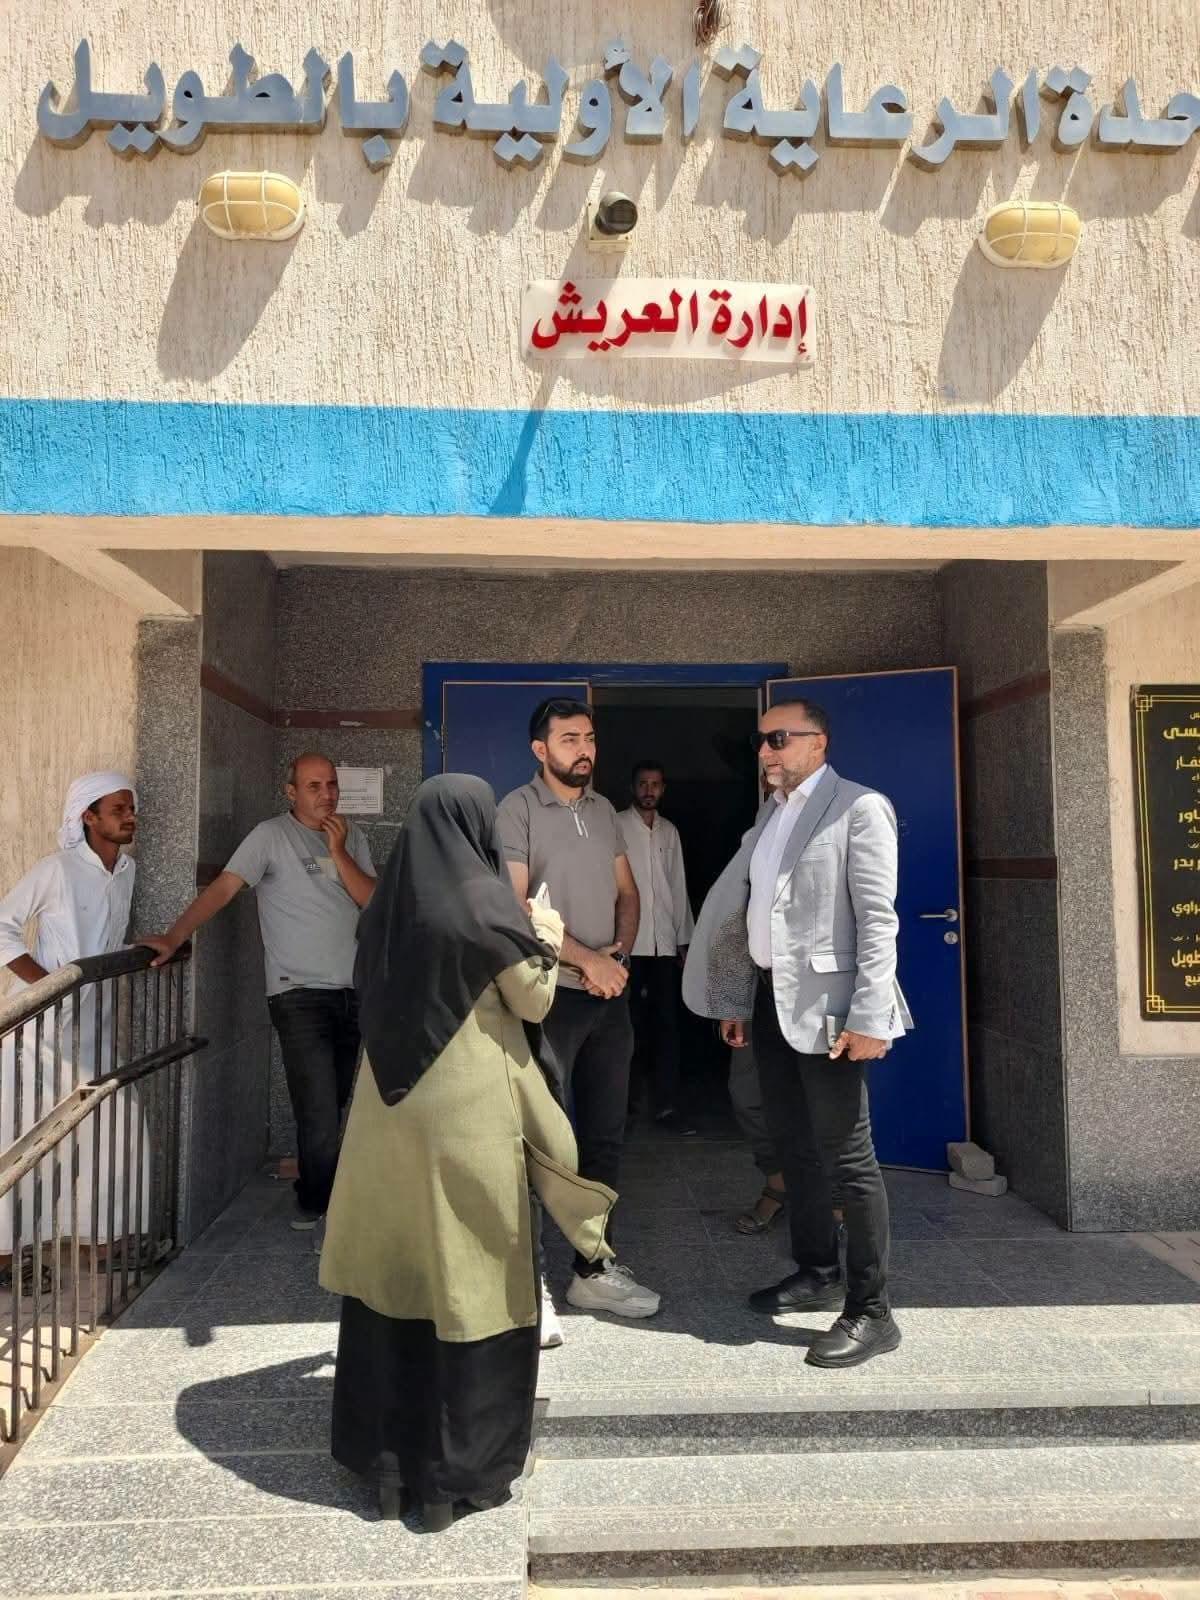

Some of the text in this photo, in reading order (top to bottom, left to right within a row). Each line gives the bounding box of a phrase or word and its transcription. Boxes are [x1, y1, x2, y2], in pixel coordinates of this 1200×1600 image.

[37, 38, 410, 171] بالطويل
[420, 39, 701, 169] الأولية
[711, 43, 1039, 177] الرعاية
[531, 281, 808, 355] إدارة العريش
